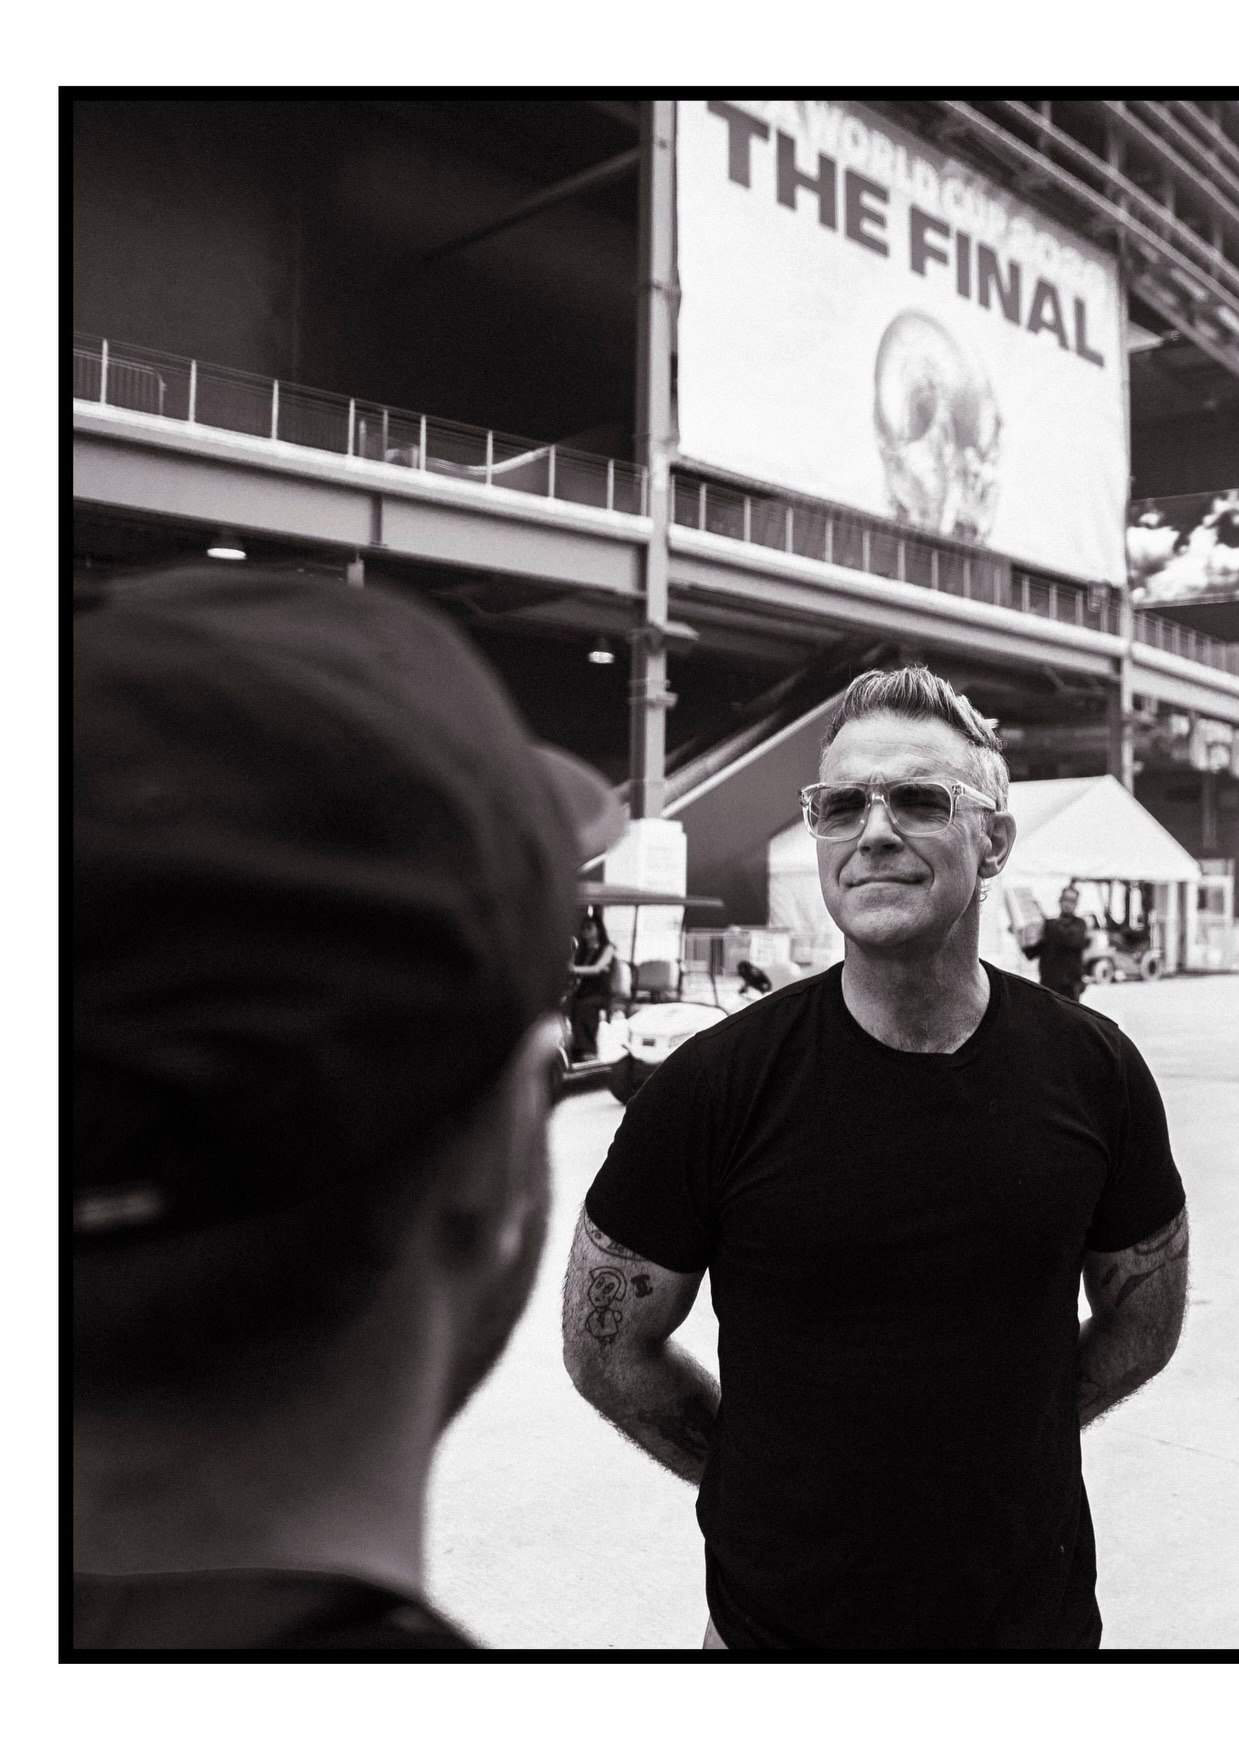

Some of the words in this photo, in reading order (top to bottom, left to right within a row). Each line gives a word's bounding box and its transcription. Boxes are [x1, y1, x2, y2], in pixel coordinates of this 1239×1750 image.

[707, 101, 889, 258] THE
[909, 203, 1104, 368] FINAL
[806, 101, 938, 209] WORLD
